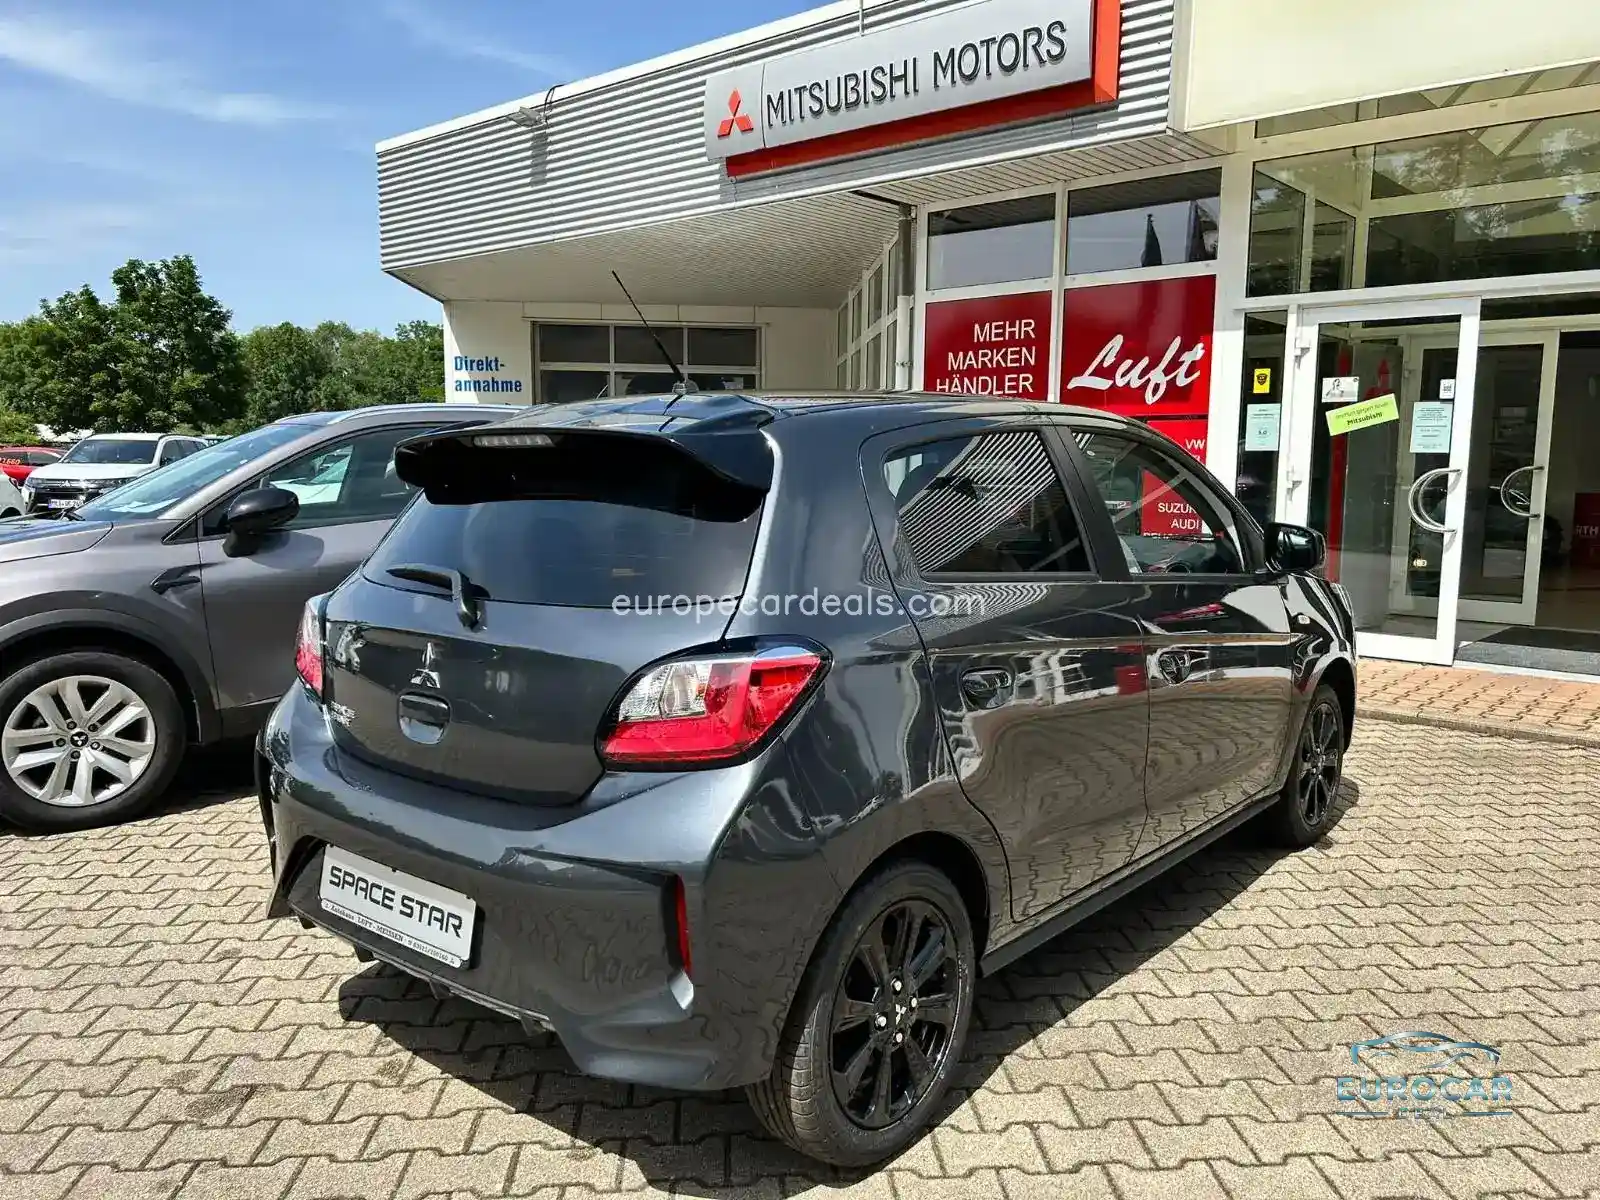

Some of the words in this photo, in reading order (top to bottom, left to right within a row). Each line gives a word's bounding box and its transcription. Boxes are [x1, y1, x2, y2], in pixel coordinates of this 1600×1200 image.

[766, 56, 919, 126] MITSUBISHI
[933, 20, 1067, 89] MOTORS
[974, 319, 1036, 342] MEHR
[454, 355, 506, 372] Direkt-
[947, 346, 1036, 371] MARKEN
[1067, 334, 1205, 405] Luft
[454, 376, 523, 393] annahme
[1346, 411, 1383, 426] Mitsubishi
[1185, 439, 1206, 450] VW
[1170, 518, 1200, 530] AUDI
[329, 865, 396, 911] SPACE
[400, 894, 463, 939] STAR
